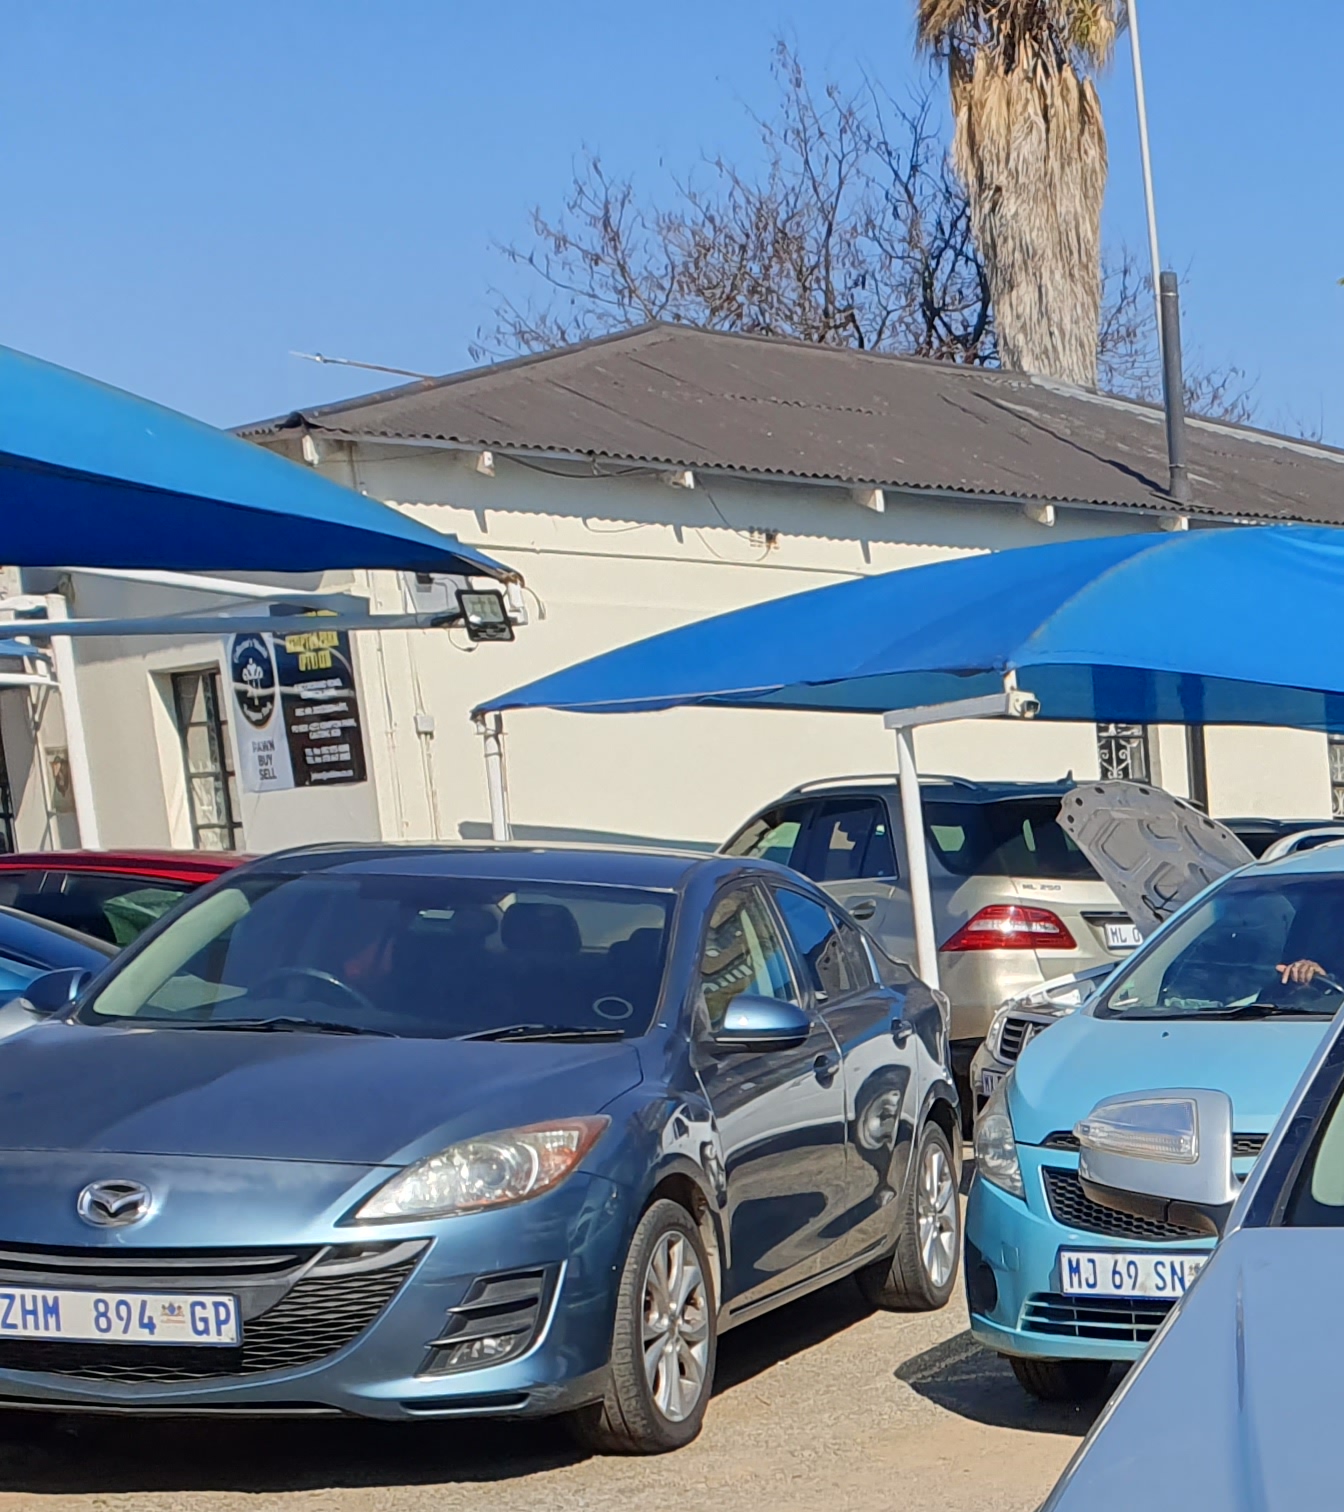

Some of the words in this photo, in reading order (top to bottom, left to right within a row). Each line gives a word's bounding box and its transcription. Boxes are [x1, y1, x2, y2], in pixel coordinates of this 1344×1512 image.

[258, 754, 273, 766] BUY
[259, 768, 277, 780] SELL
[1111, 927, 1126, 943] ML
[1068, 1257, 1097, 1289] MJ
[1111, 1257, 1138, 1290] 69
[1155, 1259, 1186, 1292] SN
[1, 1294, 62, 1332] ZHM
[94, 1298, 156, 1336] 894
[190, 1300, 231, 1337] GP
